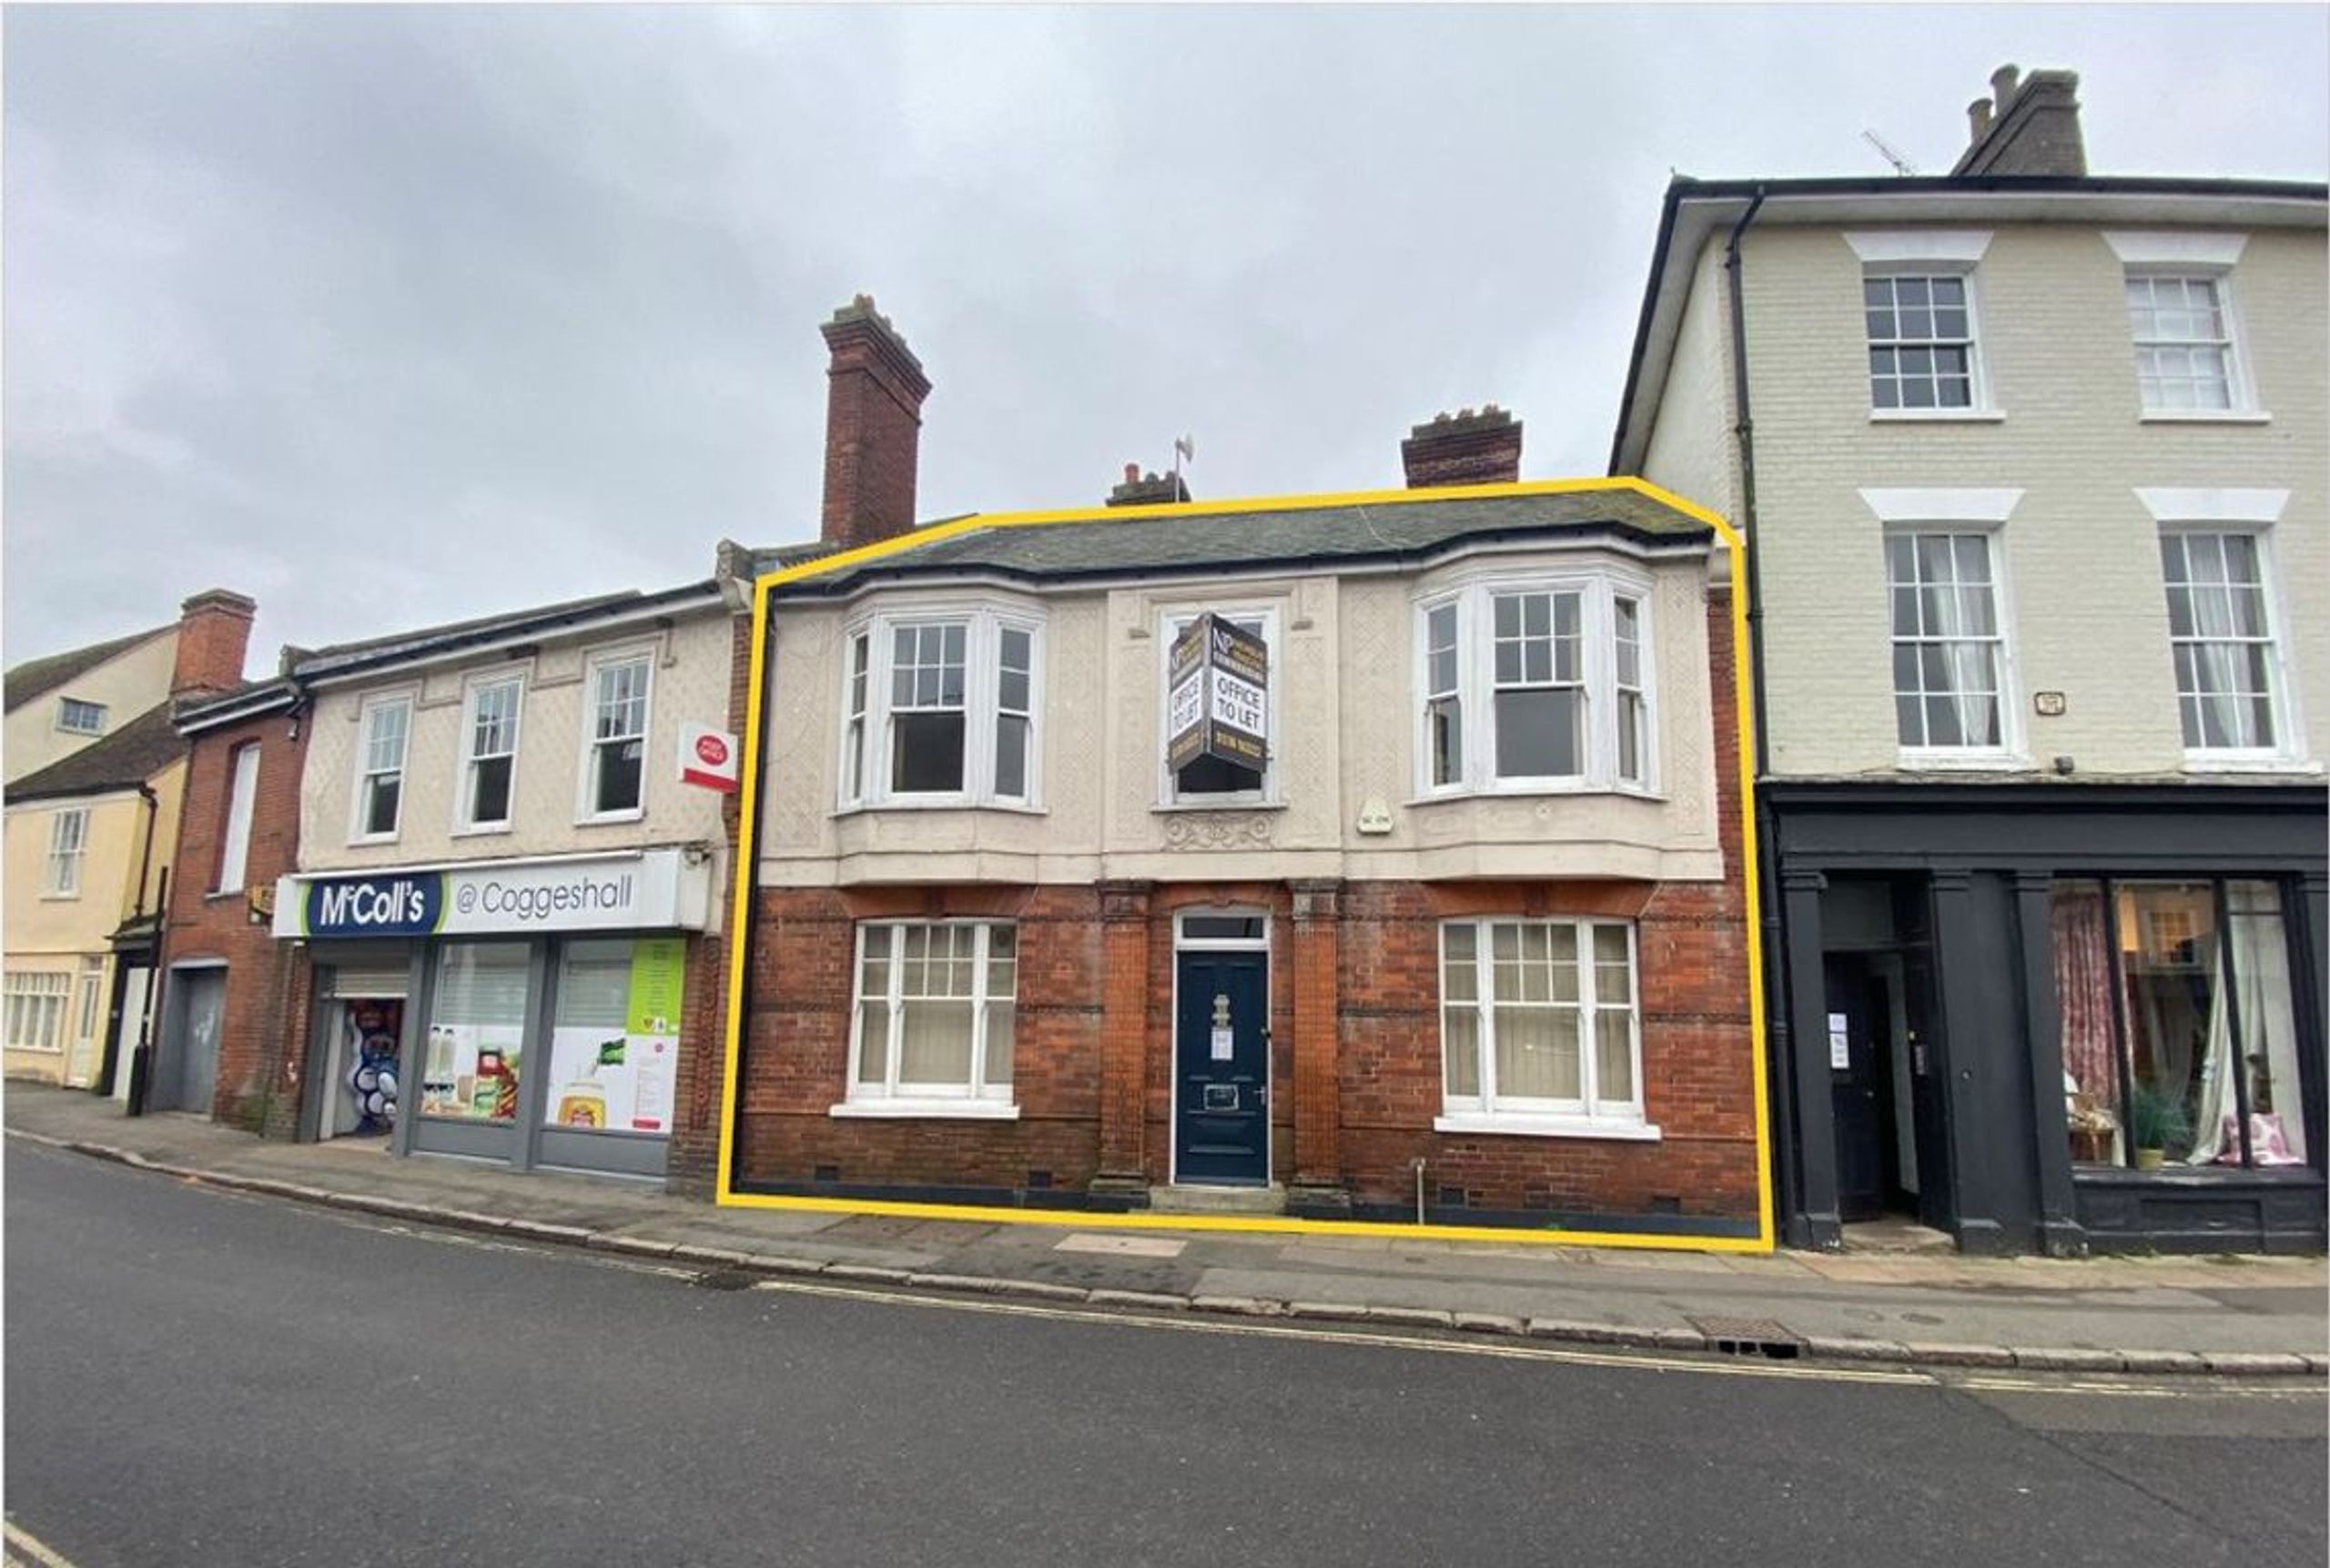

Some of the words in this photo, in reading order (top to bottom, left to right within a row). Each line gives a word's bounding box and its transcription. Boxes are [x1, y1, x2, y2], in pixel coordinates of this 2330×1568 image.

[1217, 677, 1260, 710] OFFICE
[1217, 698, 1235, 720] TO
[1239, 706, 1261, 729] LET
[320, 881, 425, 926] McColl's
[459, 883, 478, 914] @
[481, 875, 633, 919] Coggeshall
